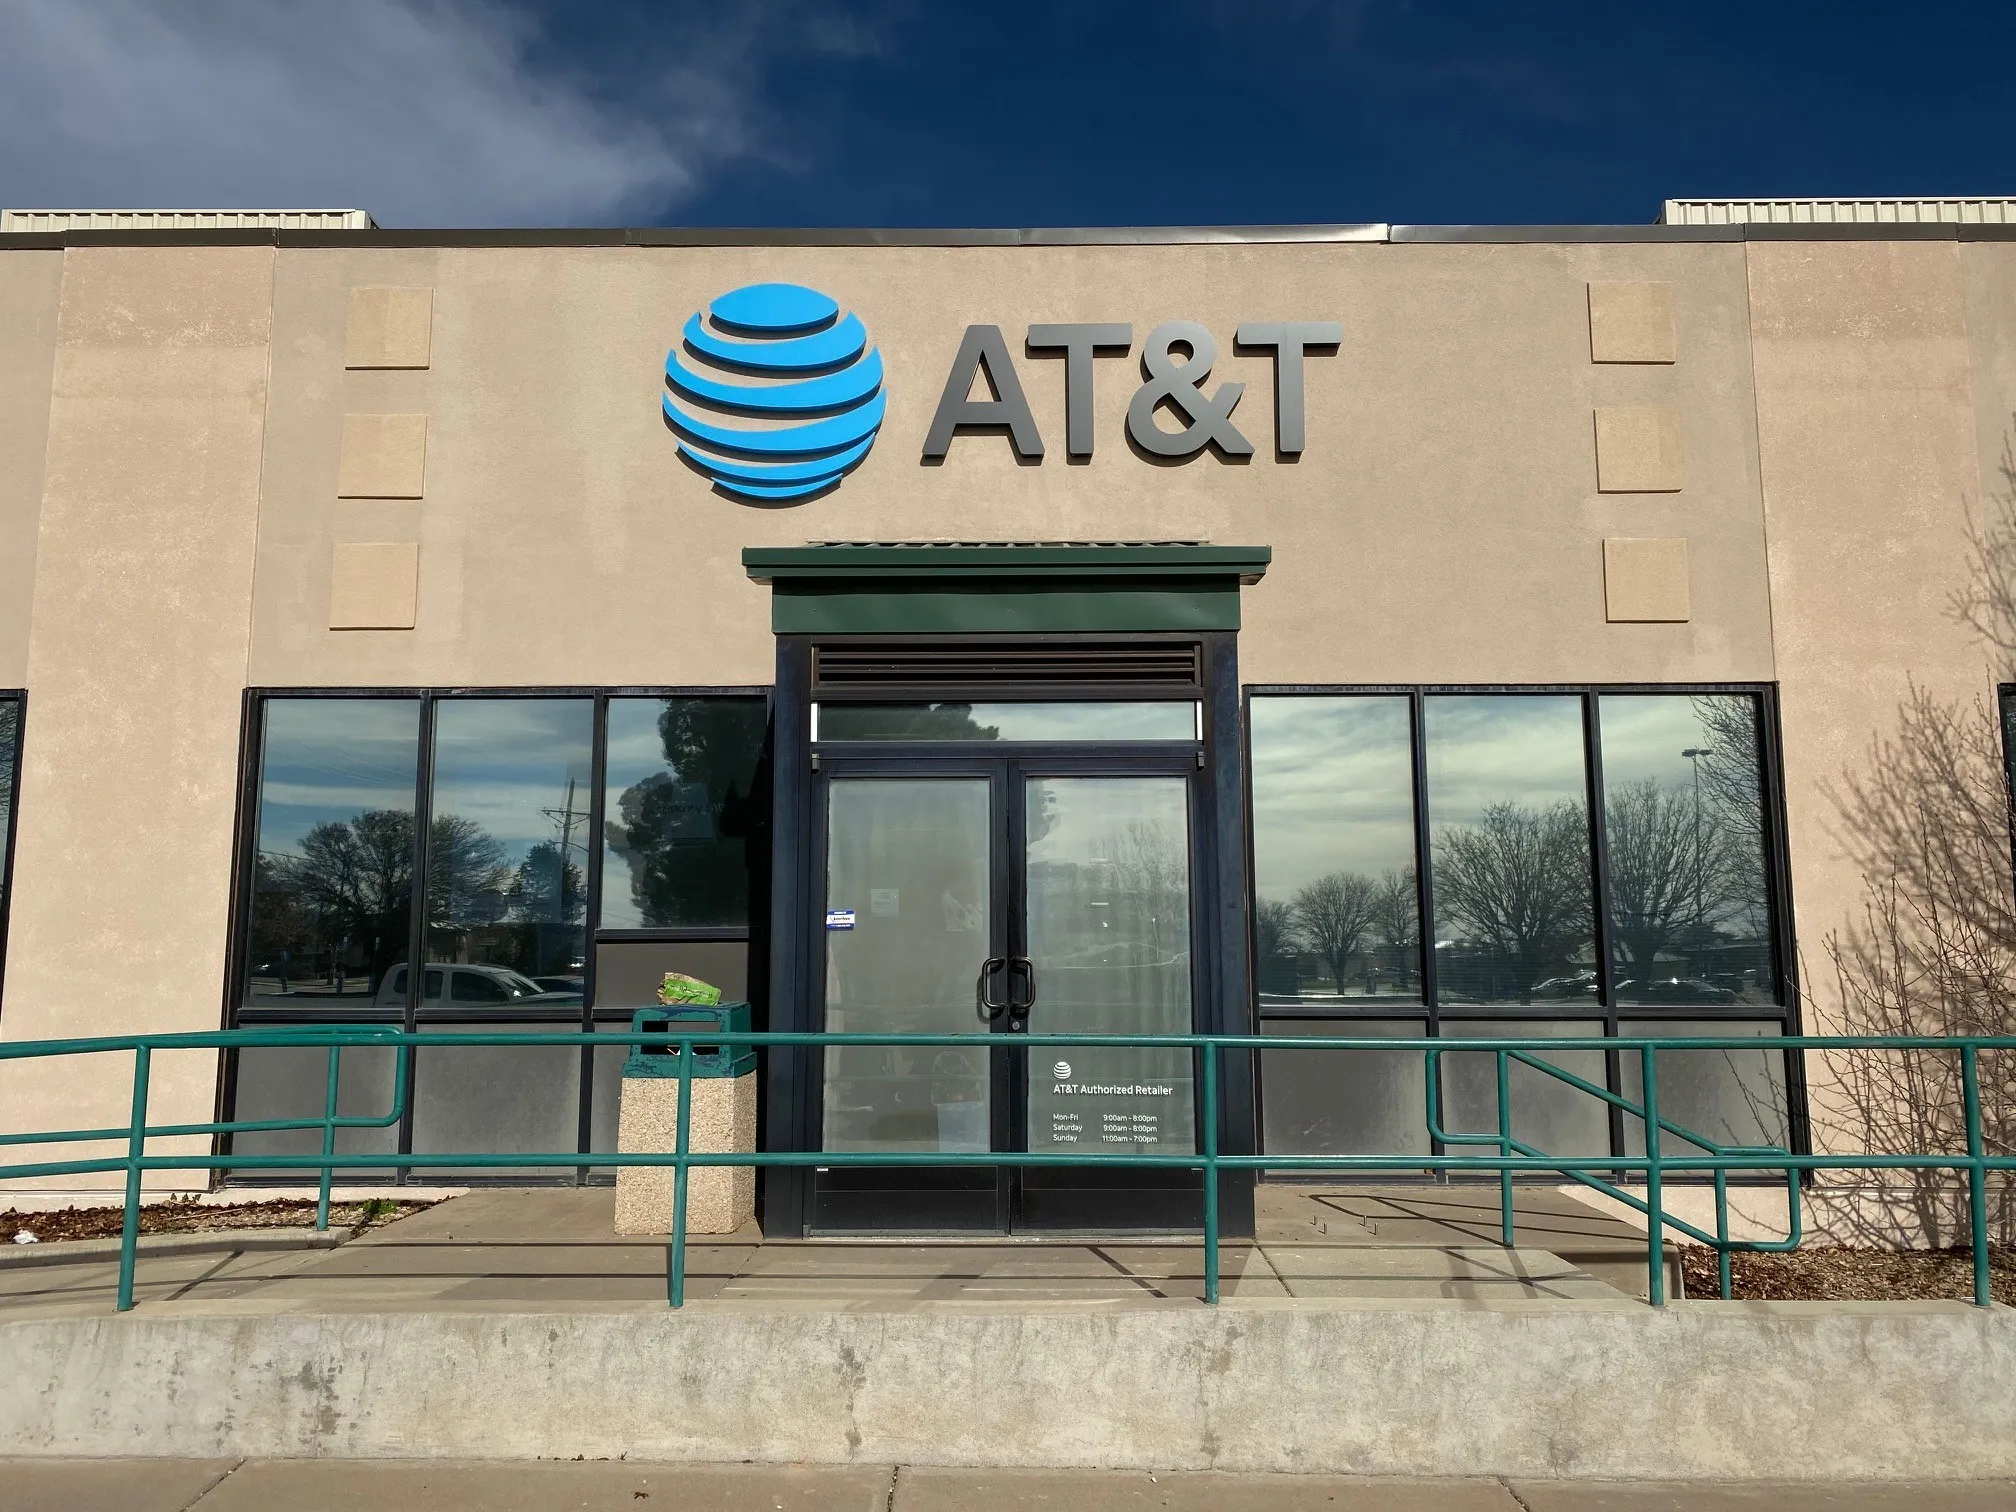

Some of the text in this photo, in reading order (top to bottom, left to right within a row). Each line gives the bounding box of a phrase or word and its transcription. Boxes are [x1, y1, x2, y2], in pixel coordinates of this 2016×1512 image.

[920, 319, 1344, 460] AT&T
[1053, 1084, 1173, 1095] AT&T Authorized Retailer
[1053, 1113, 1079, 1121] Mon-Fri
[1102, 1114, 1128, 1122] 9:00am
[1132, 1114, 1158, 1123] 8:00pm
[1053, 1123, 1083, 1133] Saturday
[1102, 1124, 1128, 1132] 9:00am
[1132, 1124, 1158, 1134] 8:00pm
[1053, 1133, 1078, 1143] Sunday
[1133, 1135, 1158, 1144] 7:00pm
